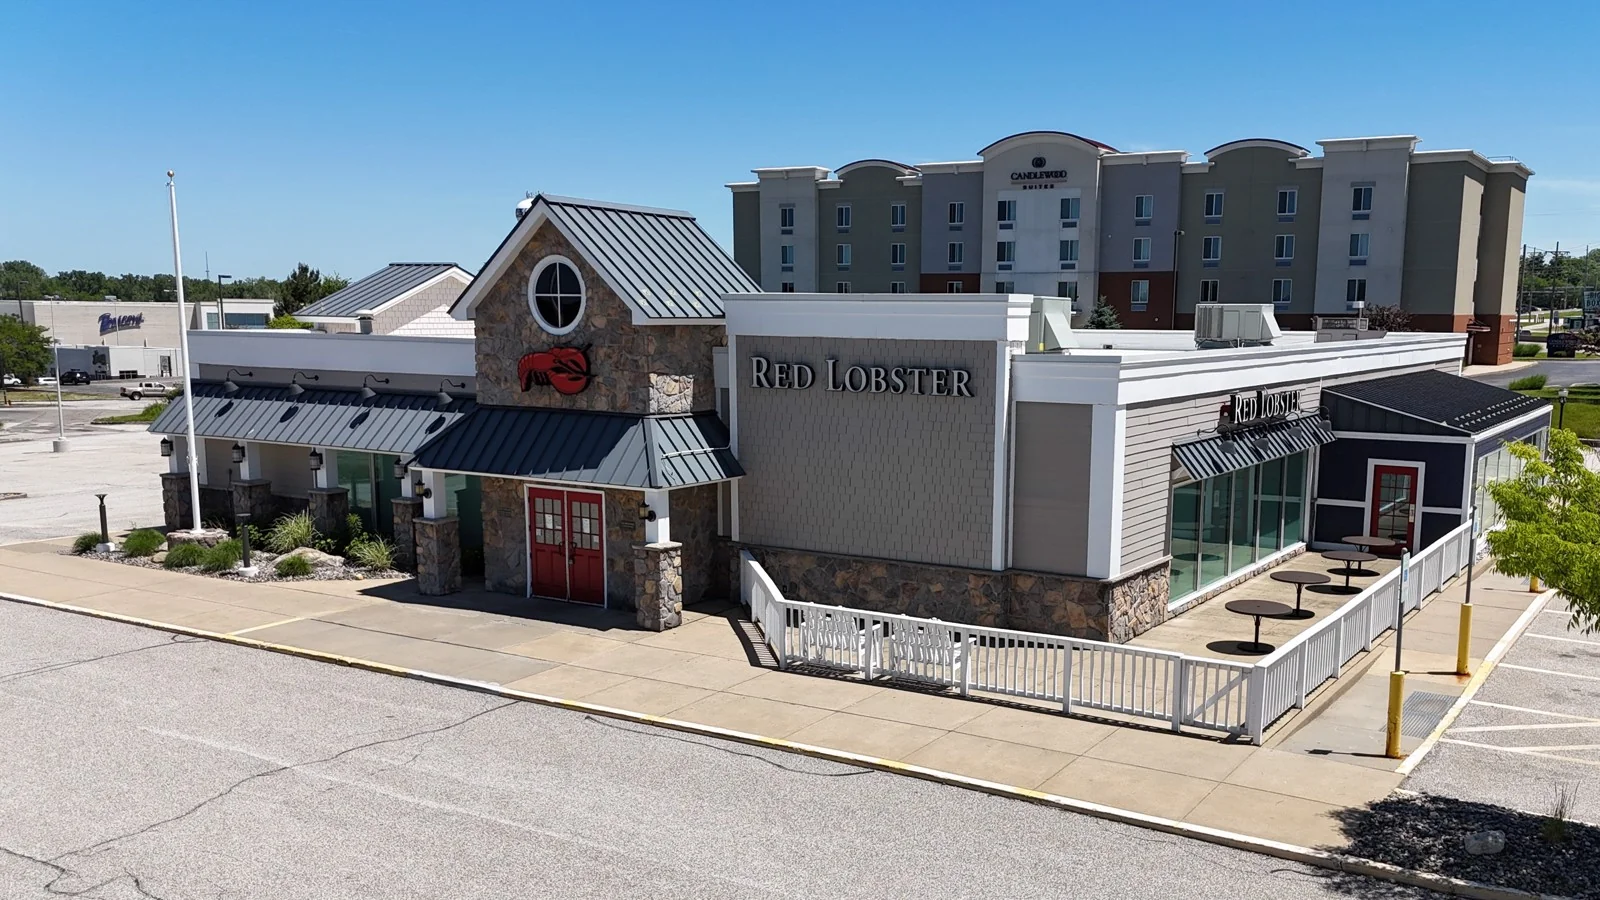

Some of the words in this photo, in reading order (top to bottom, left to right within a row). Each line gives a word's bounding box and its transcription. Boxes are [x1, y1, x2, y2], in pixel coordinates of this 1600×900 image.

[750, 356, 815, 390] RED
[825, 358, 973, 397] LOBSTER
[1234, 394, 1257, 424] RED
[1260, 390, 1301, 418] LOBSTER
